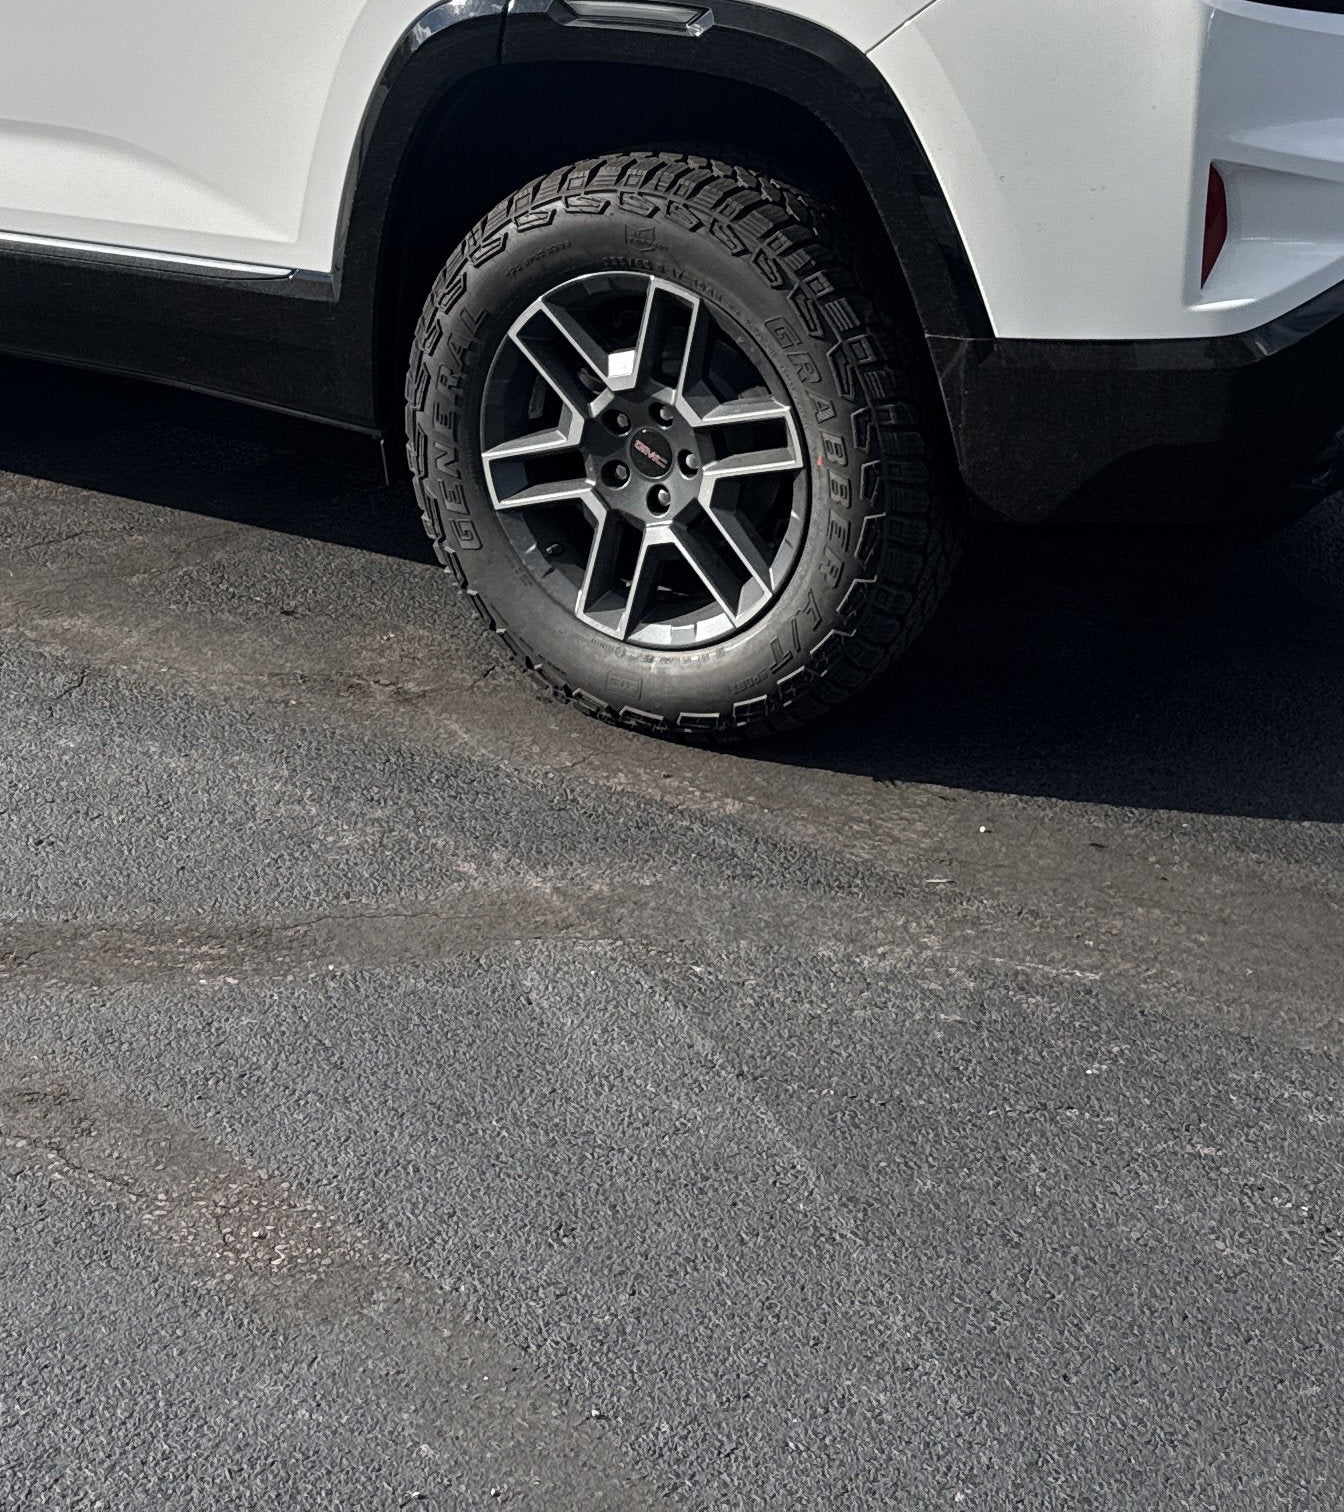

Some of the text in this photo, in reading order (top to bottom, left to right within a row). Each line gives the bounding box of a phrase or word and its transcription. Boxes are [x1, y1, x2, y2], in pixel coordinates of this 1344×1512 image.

[433, 309, 490, 551] GENERAL
[634, 439, 668, 468] GMC
[764, 316, 853, 590] GRABBER
